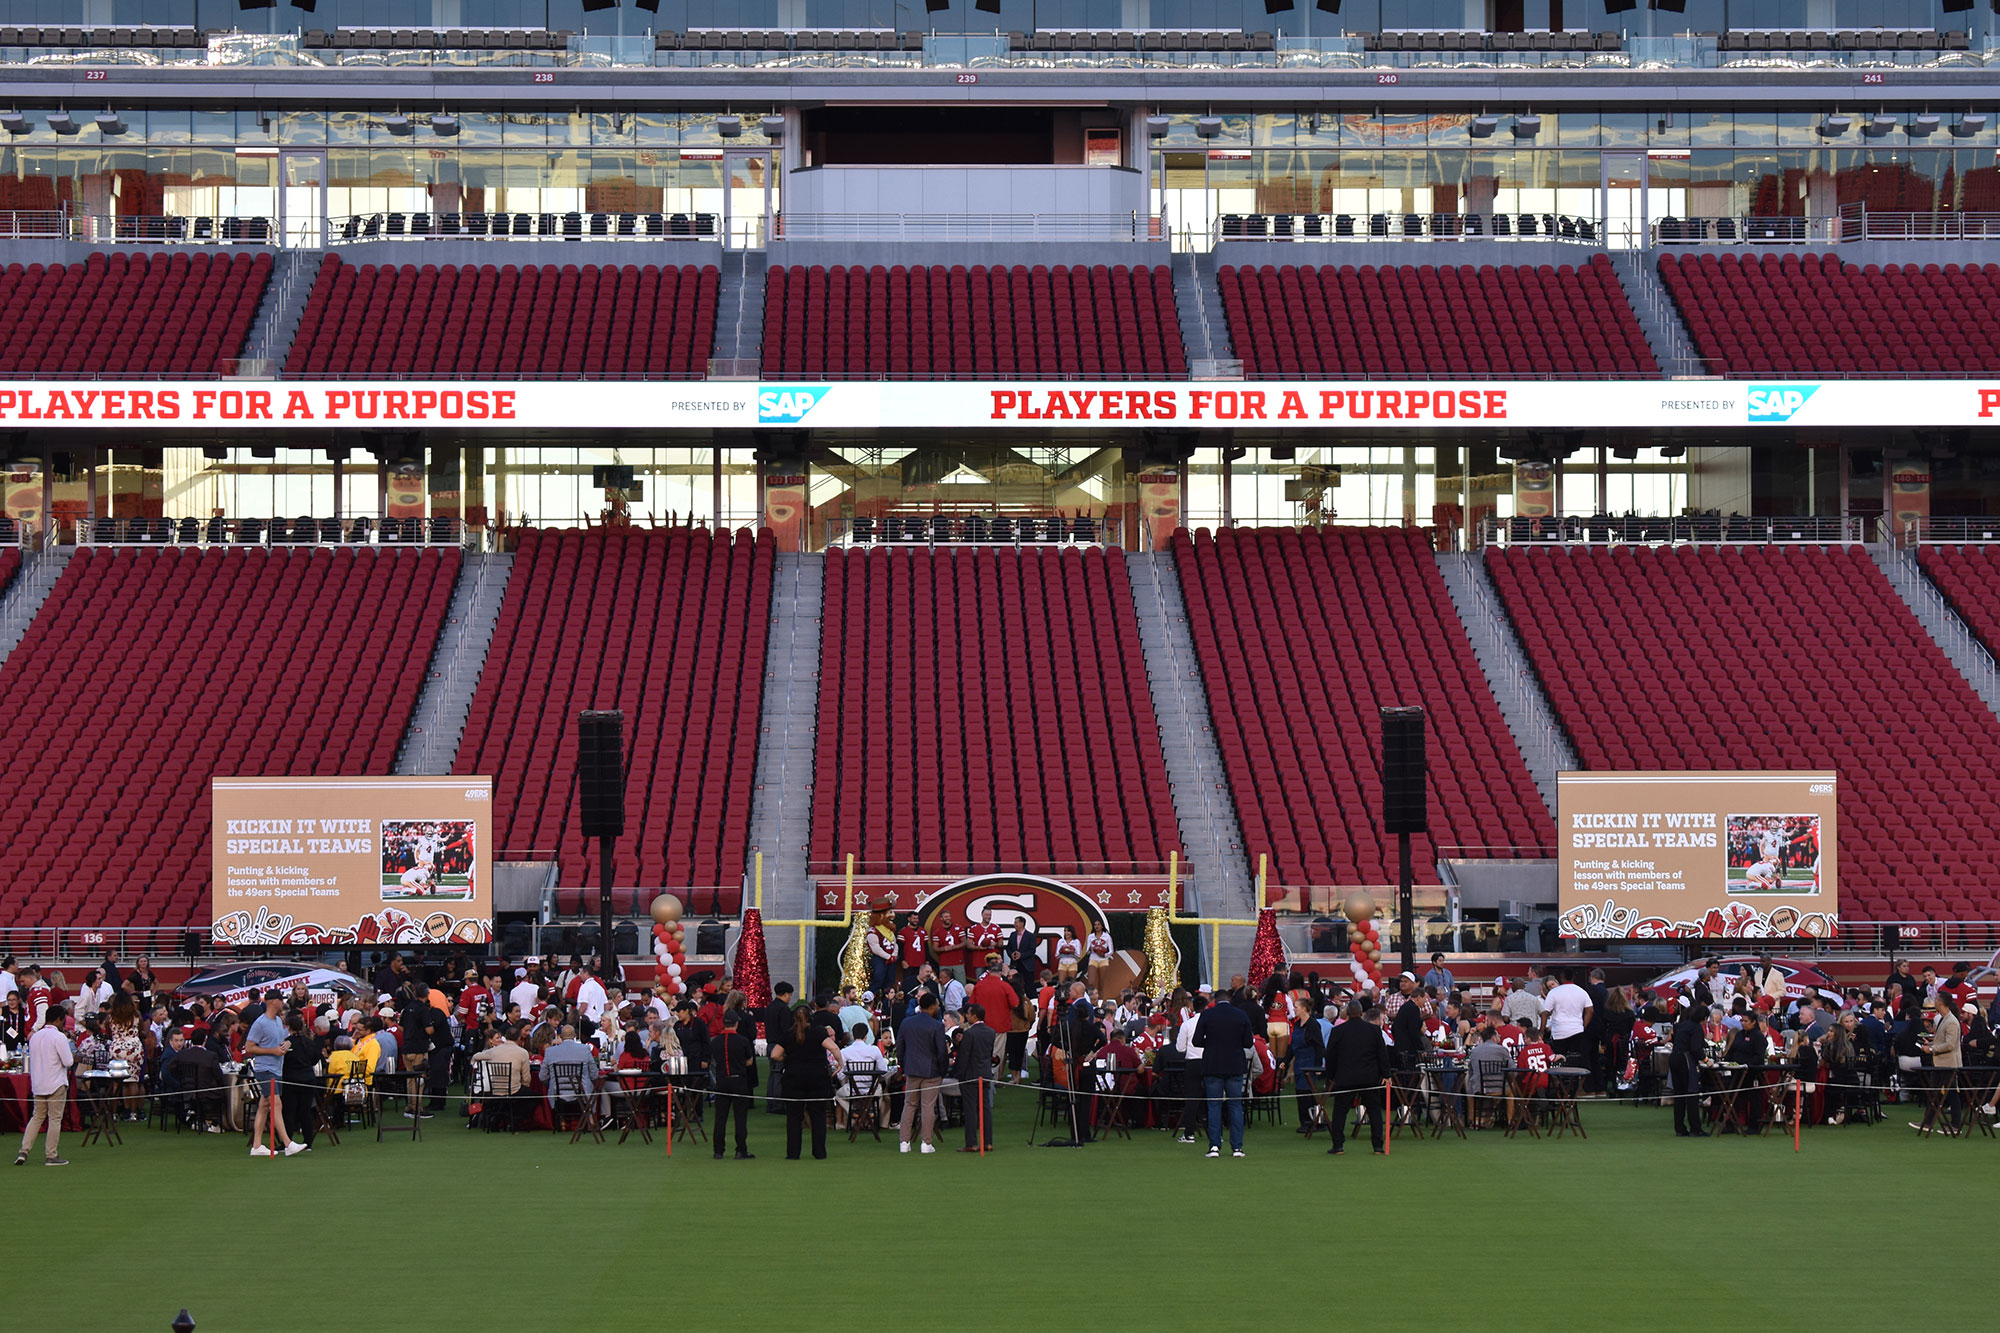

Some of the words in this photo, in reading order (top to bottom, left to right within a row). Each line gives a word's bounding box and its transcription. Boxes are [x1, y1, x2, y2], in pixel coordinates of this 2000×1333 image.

[87, 71, 105, 80] 237
[535, 73, 553, 82] 238
[958, 74, 976, 83] 239
[1379, 75, 1397, 84] 240
[1864, 74, 1882, 83] 241
[0, 390, 180, 419] PLAYERS
[193, 390, 273, 419] FOR
[283, 390, 315, 419] A
[325, 390, 516, 419] PURPOSE
[671, 401, 730, 411] PRESENTED
[733, 401, 746, 411] BY
[759, 391, 815, 418] SAP
[990, 390, 1177, 419] PLAYERS
[1189, 390, 1268, 419] FOR
[1278, 390, 1309, 419] A
[1320, 390, 1507, 419] PURPOSE
[1661, 400, 1719, 410] PRESENTED
[1722, 400, 1735, 410] BY
[1748, 390, 1804, 417] SAP
[465, 789, 489, 798] 49ERS
[1809, 784, 1833, 793] 49ERS
[1572, 814, 1638, 829] KICKIN
[1642, 813, 1662, 828] IT
[1664, 813, 1717, 828] WITH
[226, 819, 293, 835] KICKIN
[296, 819, 317, 834] IT
[319, 819, 372, 834] WITH
[1572, 833, 1649, 848] SPECIAL
[1653, 832, 1717, 848] TEAMS
[226, 838, 304, 854] SPECIAL
[307, 838, 372, 853] TEAMS
[1573, 860, 1610, 871] Punting
[1612, 860, 1620, 870] &
[1621, 860, 1655, 871] kicking
[227, 866, 265, 877] Punting
[266, 866, 274, 876] &
[275, 866, 310, 877] kicking
[1573, 871, 1603, 880] lesson
[1605, 870, 1626, 880] with
[1627, 870, 1670, 880] members
[1672, 870, 1683, 880] of
[227, 877, 257, 886] lesson
[259, 876, 280, 886] with
[282, 876, 325, 886] members
[327, 876, 337, 886] of
[1573, 881, 1590, 891] the
[1591, 881, 1618, 891] 49ers
[1620, 881, 1654, 893] Special
[1656, 881, 1686, 891] Teams
[227, 887, 243, 897] the
[245, 887, 272, 897] 49ers
[274, 887, 308, 899] Special
[310, 887, 340, 897] Teams
[1898, 927, 1919, 937] 140
[84, 933, 103, 943] 136
[912, 936, 921, 952] 4
[1527, 1054, 1548, 1073] 85
